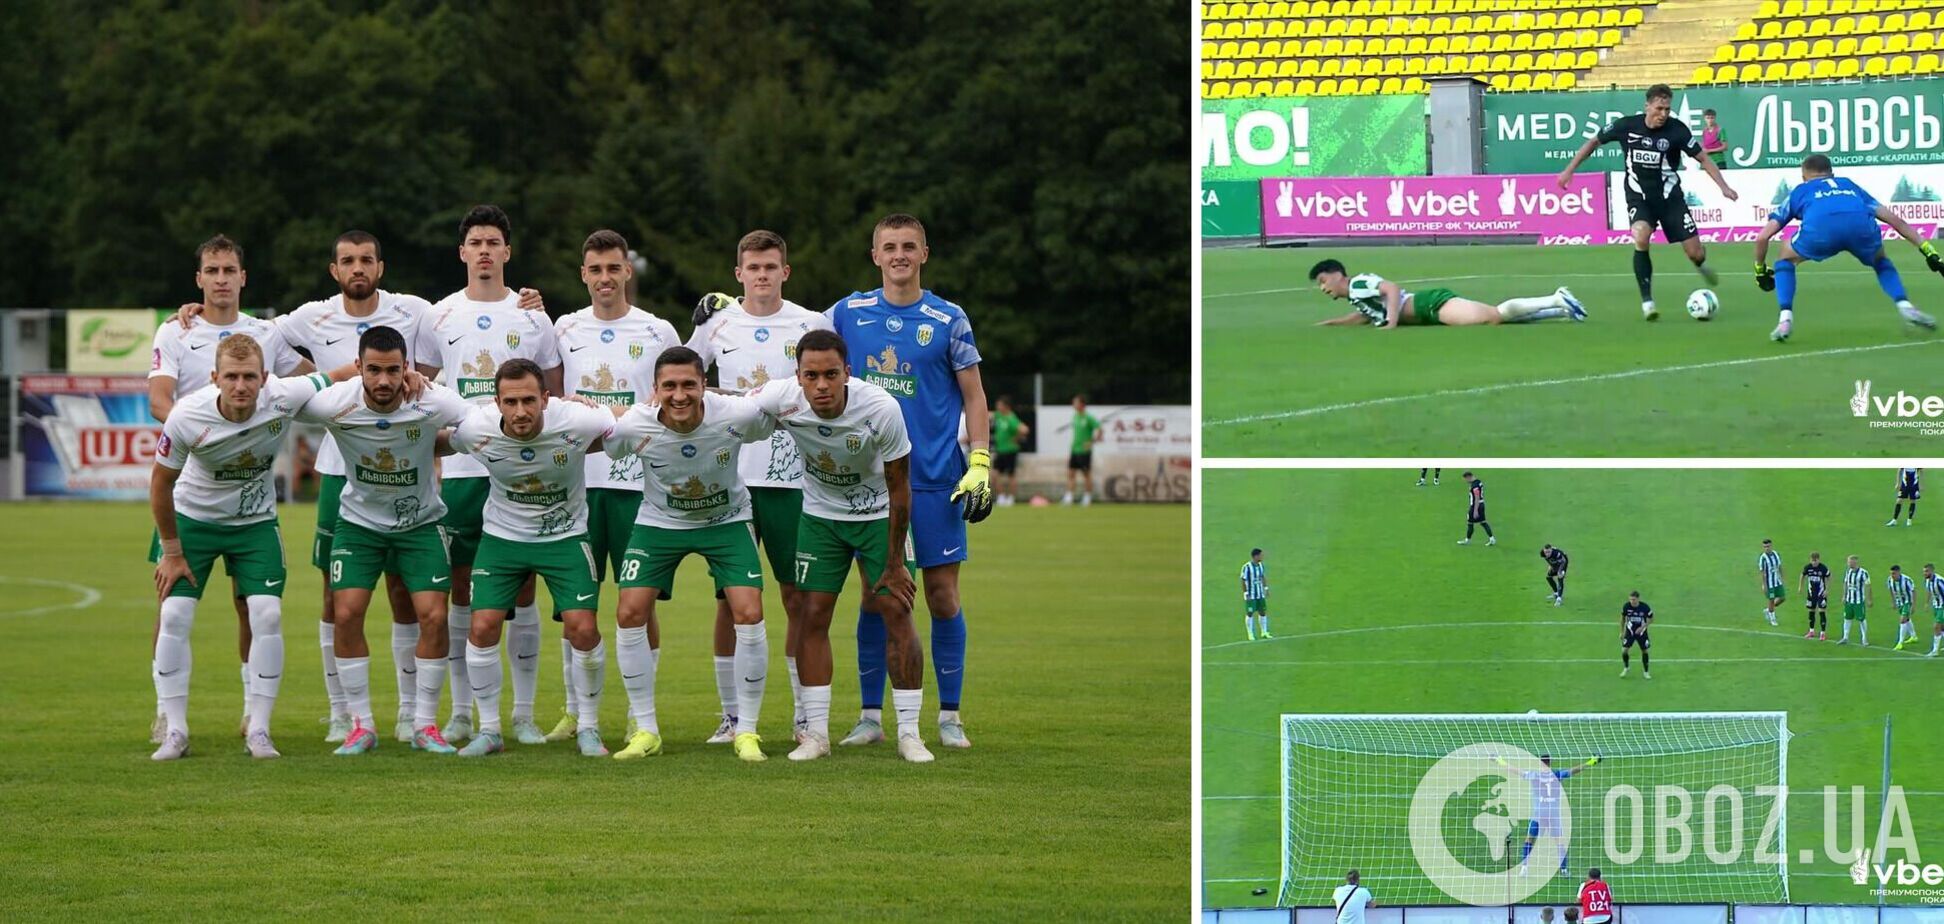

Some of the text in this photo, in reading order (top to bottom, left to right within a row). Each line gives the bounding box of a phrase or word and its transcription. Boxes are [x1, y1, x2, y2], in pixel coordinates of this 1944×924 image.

[1732, 94, 1940, 166] ЛЬВІВСЬ
[1635, 152, 1659, 163] BGV
[1865, 155, 1879, 163] ФК
[1295, 190, 1369, 218] vbet
[1406, 189, 1480, 217] vbet
[1518, 187, 1594, 215] vbet
[1346, 220, 1522, 232] ПРЕМІУМПАРТНЕР ФК "КАРПАТИ"
[461, 382, 496, 397] ЛЬВІВС
[358, 470, 416, 484] ЛЬВІВСЬКЕ
[669, 495, 727, 509] ЛЬВІВСЬКЕ
[620, 559, 640, 581] 28
[1588, 890, 1606, 901] TV
[1589, 901, 1610, 912] 021
